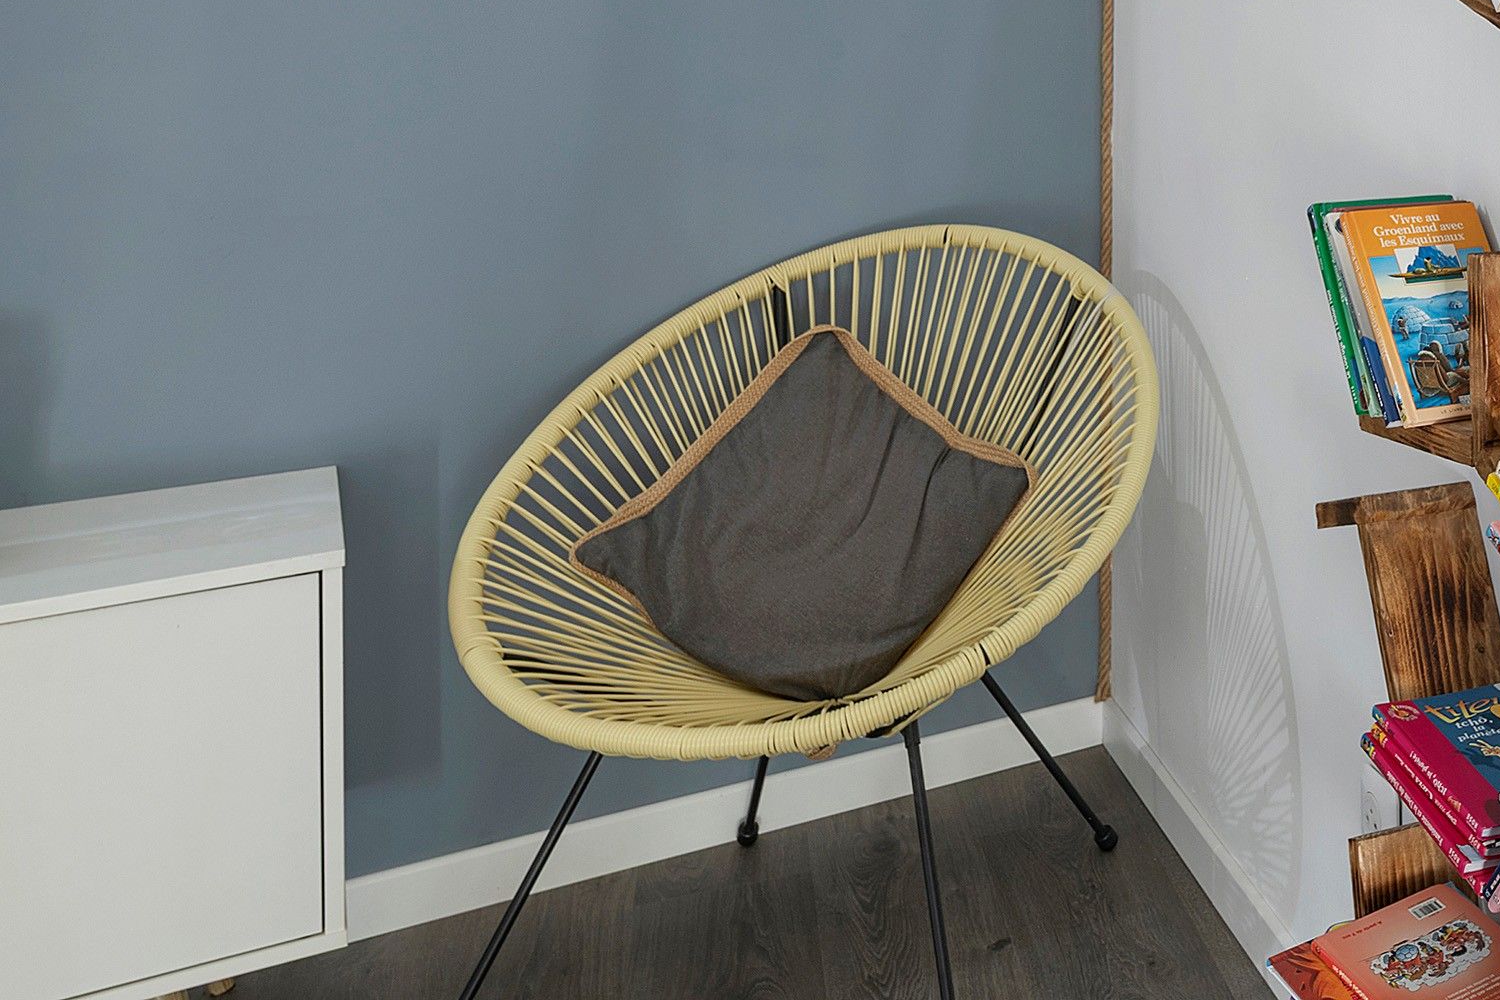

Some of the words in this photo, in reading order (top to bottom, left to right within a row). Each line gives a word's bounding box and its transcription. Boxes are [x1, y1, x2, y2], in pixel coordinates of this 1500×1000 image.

[1390, 214, 1422, 224] Vivre
[1425, 214, 1440, 222] au
[1373, 224, 1438, 238] Groenland
[1439, 221, 1464, 231] avec
[1379, 237, 1397, 248] les
[1399, 231, 1466, 248] Esquimaux
